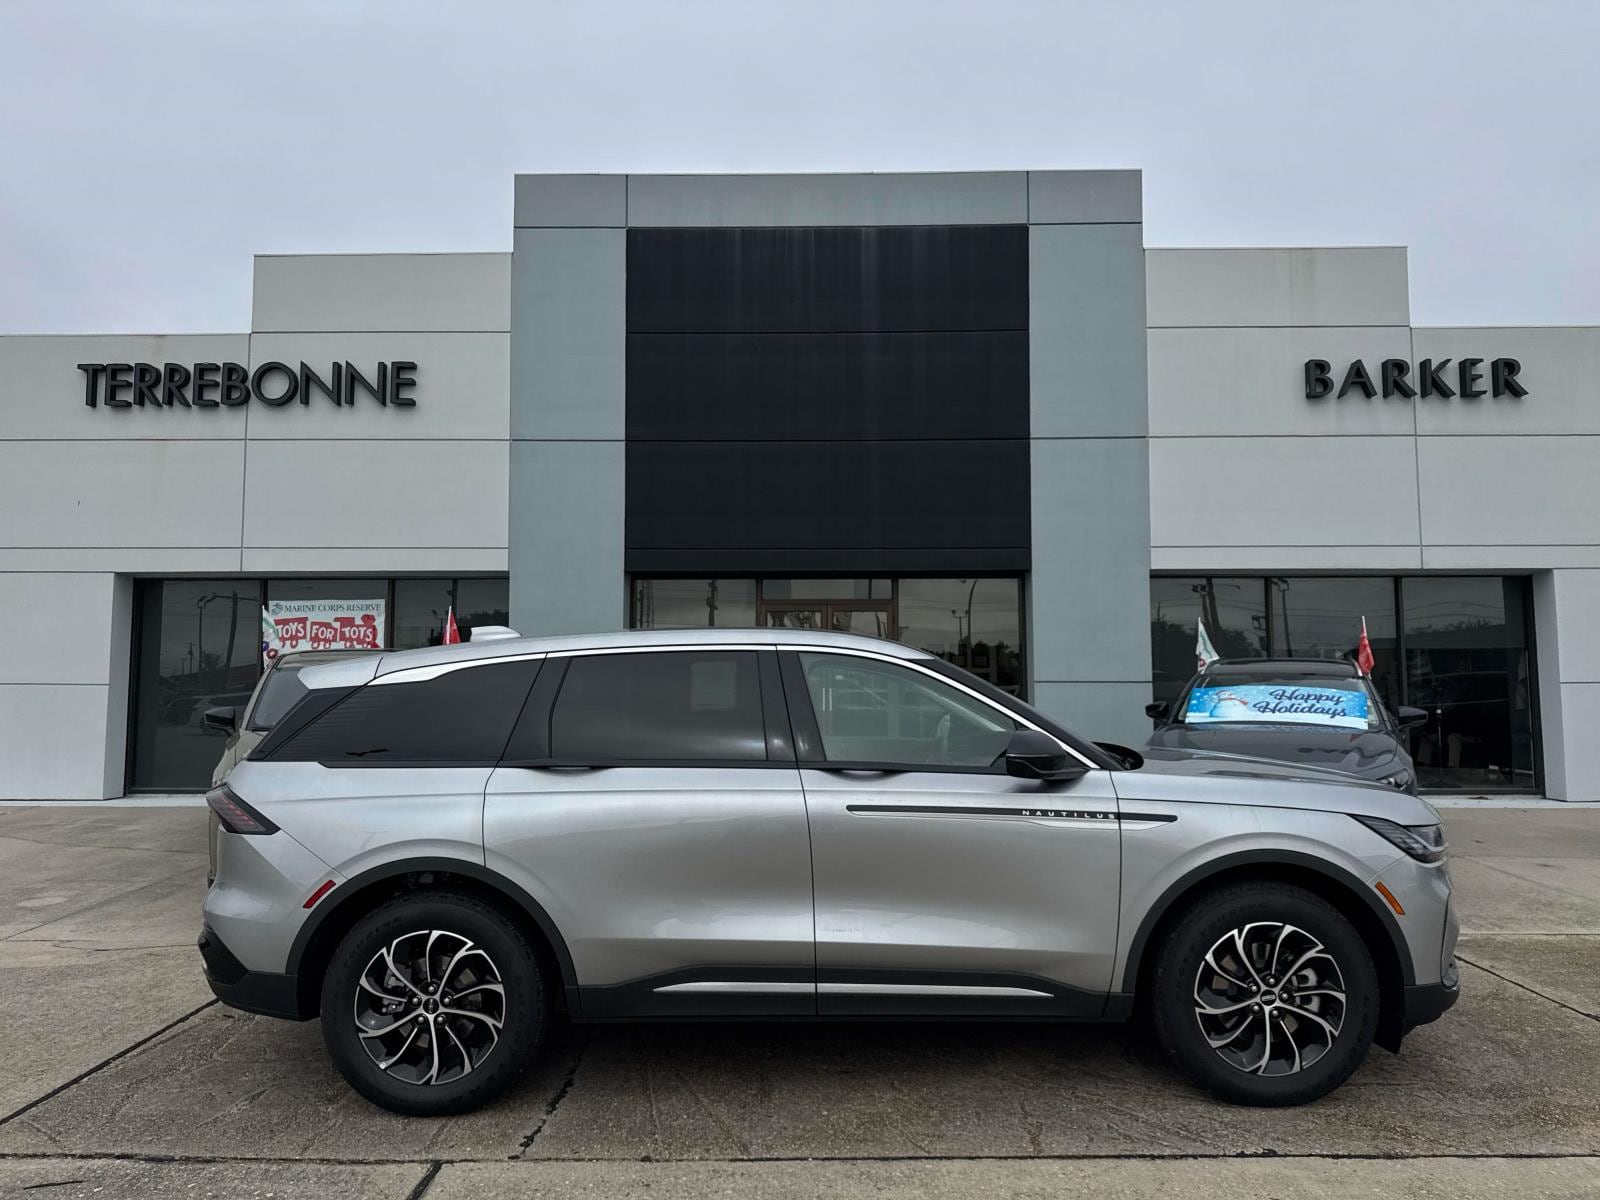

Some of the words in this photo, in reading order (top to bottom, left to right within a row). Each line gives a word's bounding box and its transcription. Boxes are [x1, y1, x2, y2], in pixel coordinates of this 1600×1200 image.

[77, 360, 417, 408] TERREBONNE
[1304, 358, 1529, 399] BARKER
[284, 604, 317, 613] MARINE
[317, 603, 345, 612] CORPS
[346, 603, 381, 612] RESERVE
[278, 622, 305, 638] TOYS
[311, 625, 335, 640] FOR
[341, 626, 373, 641] TOTS
[1269, 688, 1345, 705] Happy
[1253, 701, 1348, 719] Holidays
[1022, 810, 1115, 819] NAUTILUS
